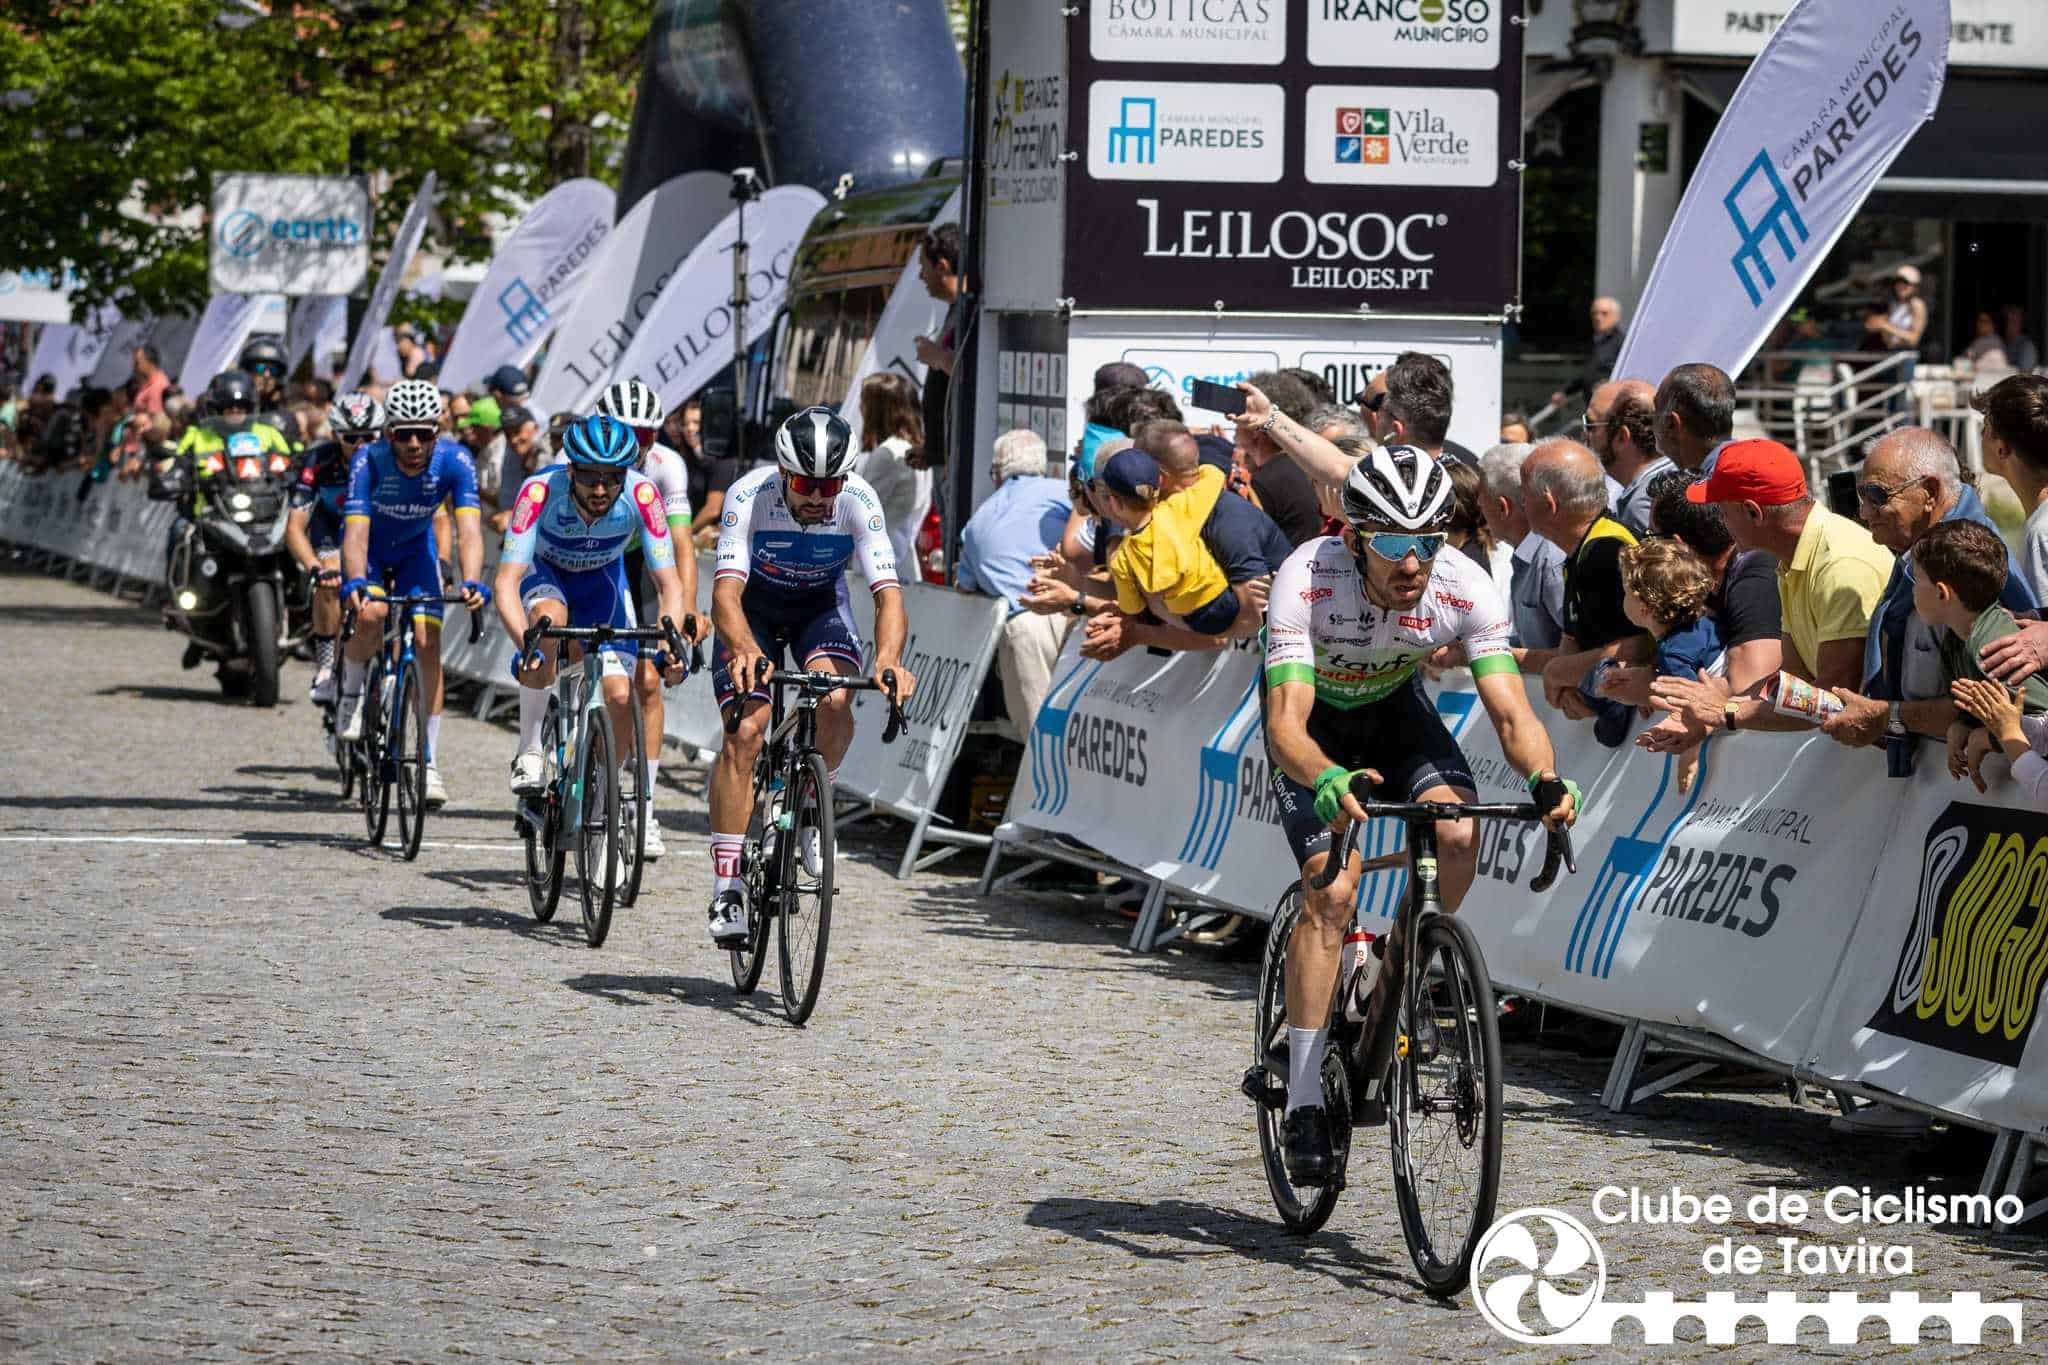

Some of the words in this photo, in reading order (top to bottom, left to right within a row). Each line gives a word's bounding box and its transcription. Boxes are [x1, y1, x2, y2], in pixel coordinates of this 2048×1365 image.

[1180, 26, 1269, 41] MUNICIPAL
[1394, 25, 1489, 43] MUNICÍPIO
[1395, 109, 1445, 133] Vila
[1792, 19, 1922, 202] PAREDES
[1160, 129, 1265, 149] PAREDES
[1395, 132, 1469, 163] Verde
[271, 216, 360, 241] earth
[537, 217, 610, 301] PAREDES
[1291, 266, 1434, 289] LEILOES.PT
[1067, 711, 1148, 787] PAREDES
[1636, 845, 1798, 938] PAREDES
